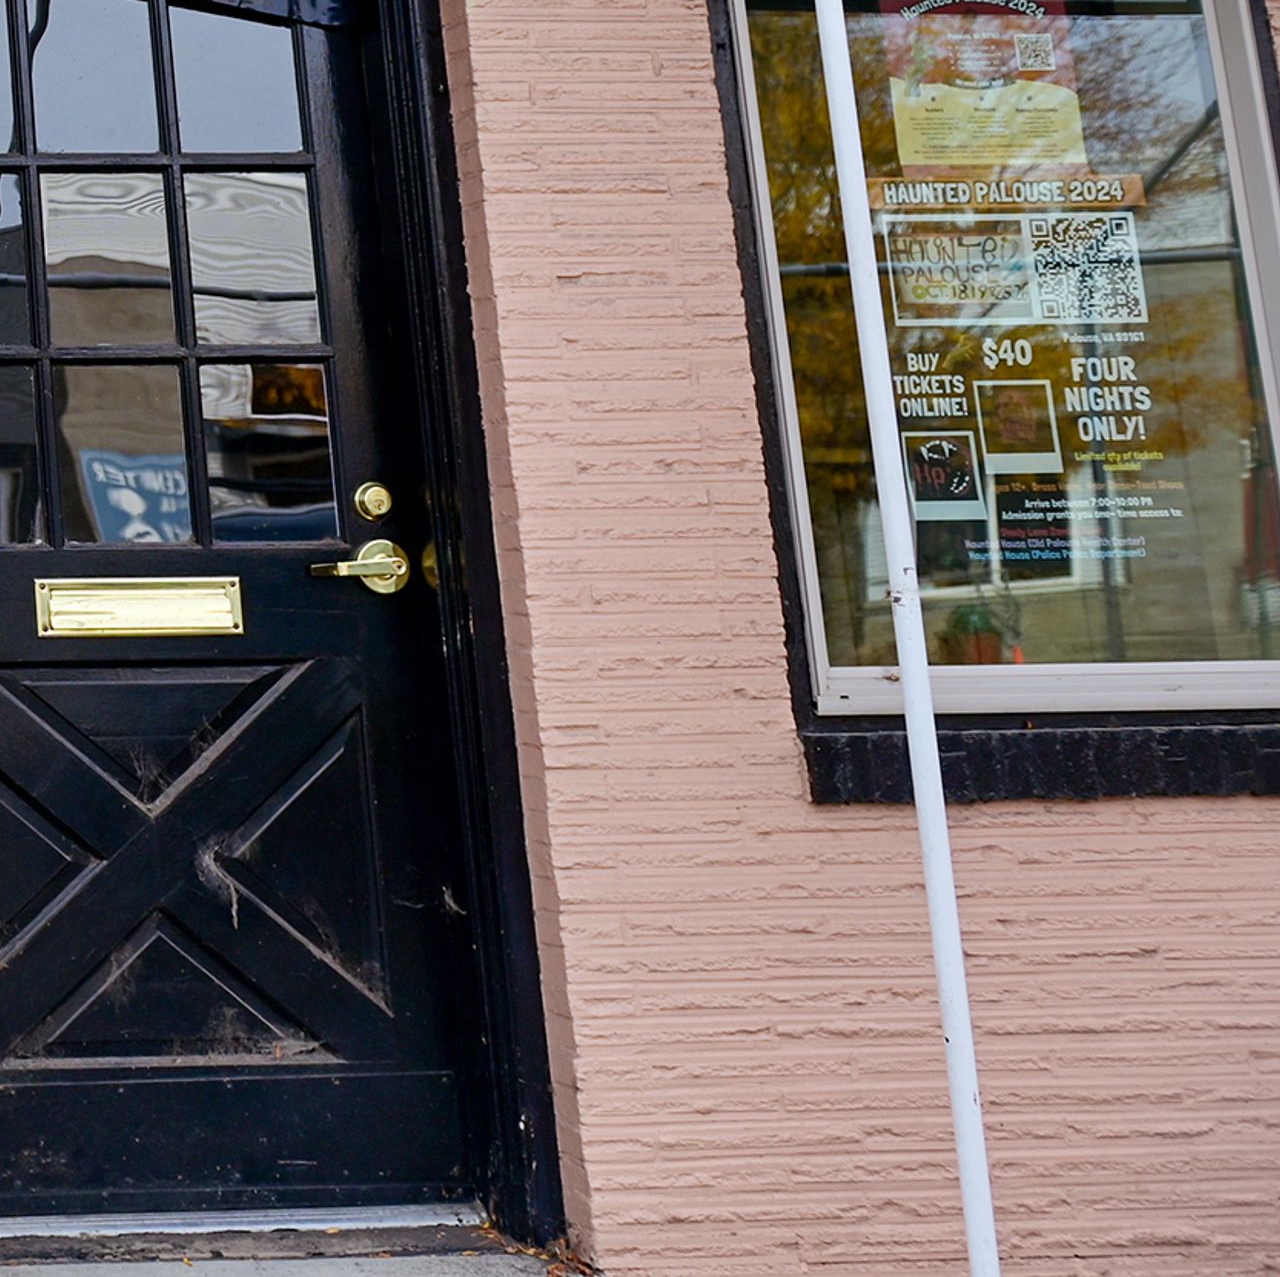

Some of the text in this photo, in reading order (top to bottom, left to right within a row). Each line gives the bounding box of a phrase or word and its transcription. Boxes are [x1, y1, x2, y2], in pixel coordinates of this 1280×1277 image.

[884, 180, 1125, 205] HAUNTED PALOUSE 2024
[907, 353, 939, 372] BUY
[982, 337, 1033, 369] $40
[1070, 356, 1137, 382] FOUR
[892, 374, 966, 396] TICKETS
[900, 397, 969, 417] ONLINE!
[1064, 386, 1152, 412] NIGHTS
[1077, 416, 1146, 442] ONLY!
[1002, 510, 1045, 520] Admission
[1024, 499, 1051, 508] Arrive
